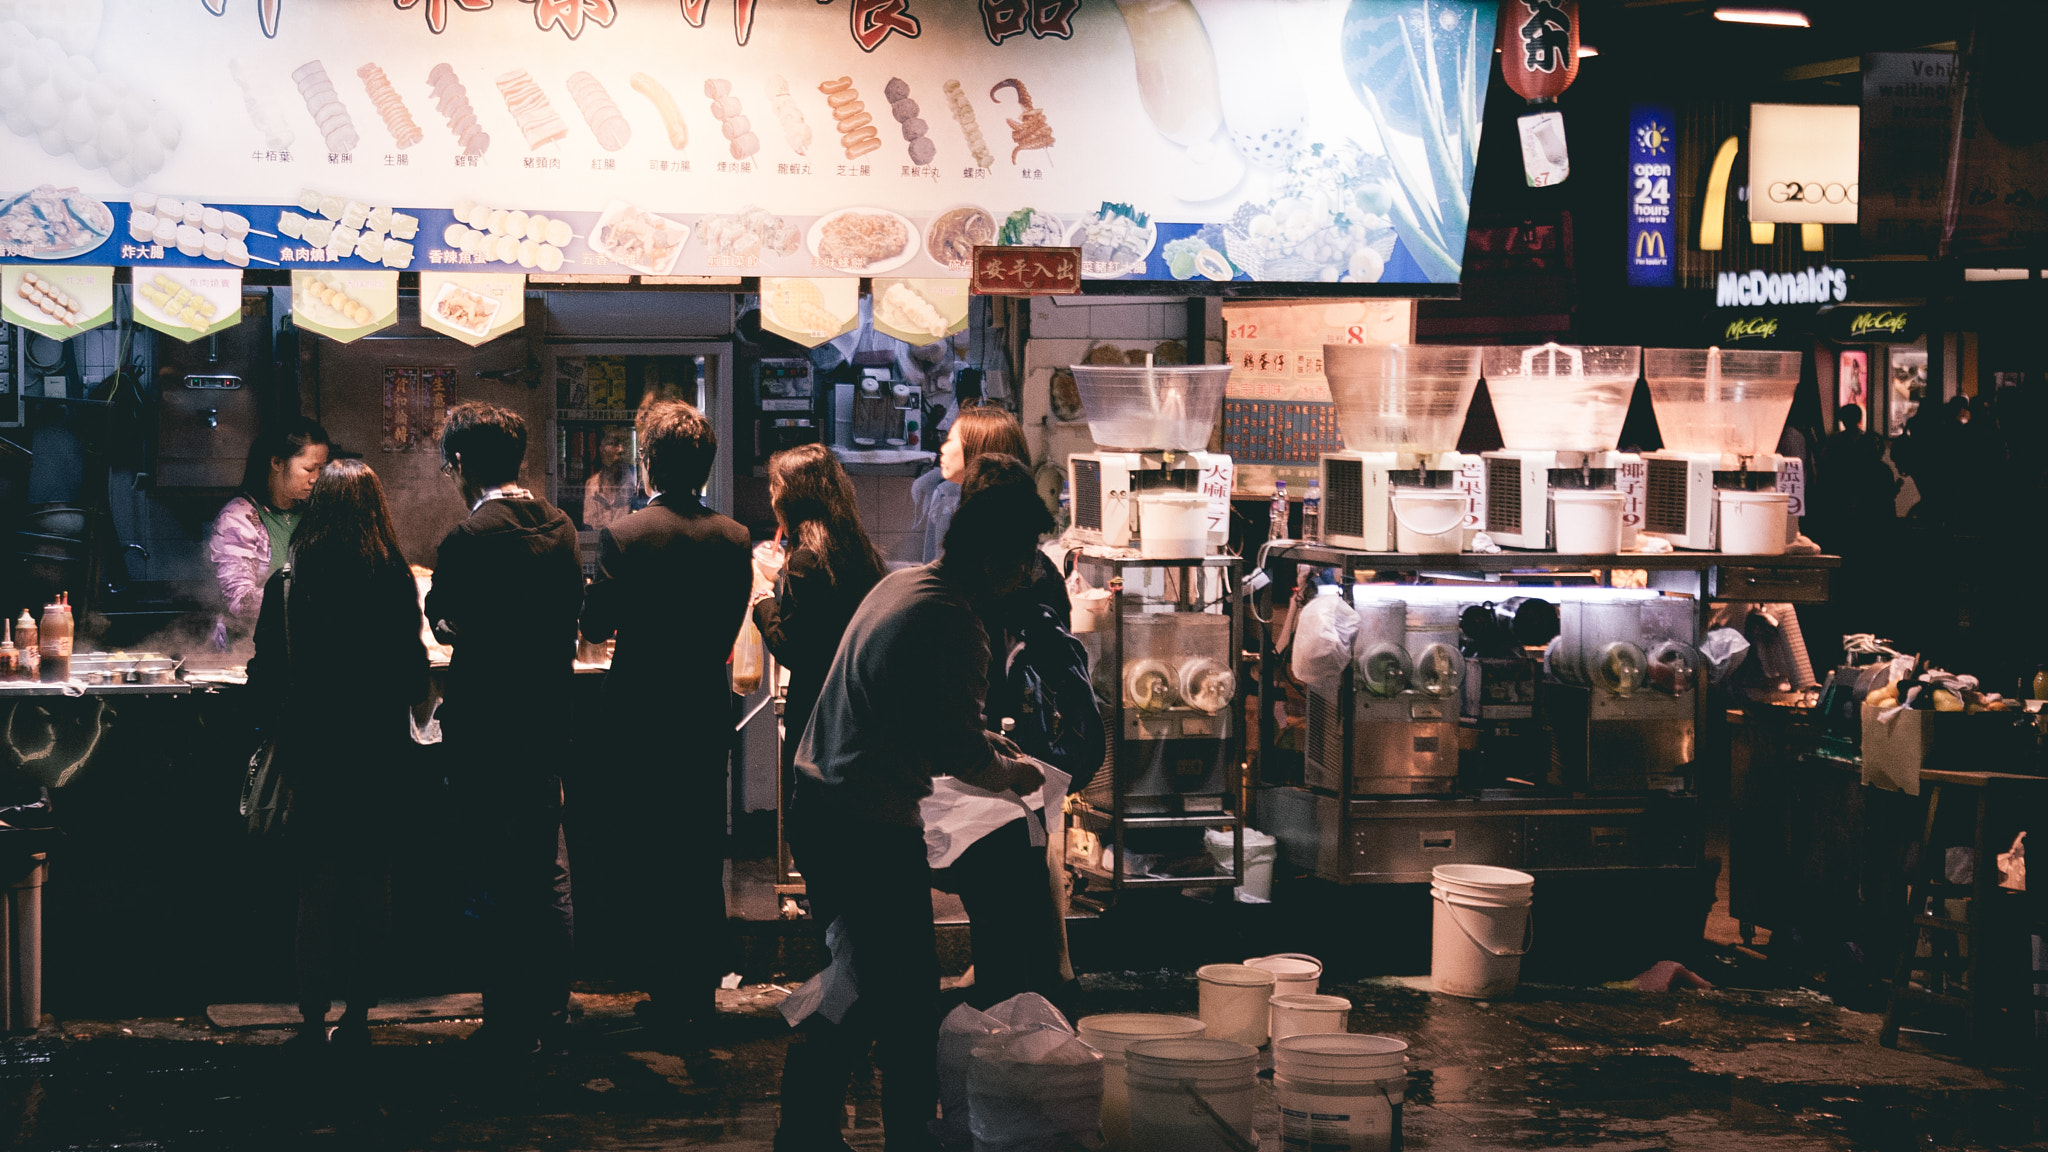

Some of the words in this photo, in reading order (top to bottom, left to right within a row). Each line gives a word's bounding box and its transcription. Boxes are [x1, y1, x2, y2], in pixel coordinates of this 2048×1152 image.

[384, 154, 409, 166] 生腸
[591, 158, 616, 170] 紅腸
[777, 163, 813, 175] 龍蝦丸
[836, 164, 871, 177] 芝士腸
[901, 165, 941, 178] 黑椒牛丸
[963, 167, 986, 179] 螺肉
[1022, 168, 1043, 180] 魷魚
[1633, 163, 1671, 178] open
[1633, 177, 1671, 204] 24
[1633, 204, 1671, 217] hours
[121, 244, 165, 260] 炸大腸
[280, 247, 340, 263] 魚肉燒賣
[428, 249, 488, 265] 香辣魚蛋
[1716, 265, 1848, 308] McDonald's
[1347, 325, 1364, 344] 8
